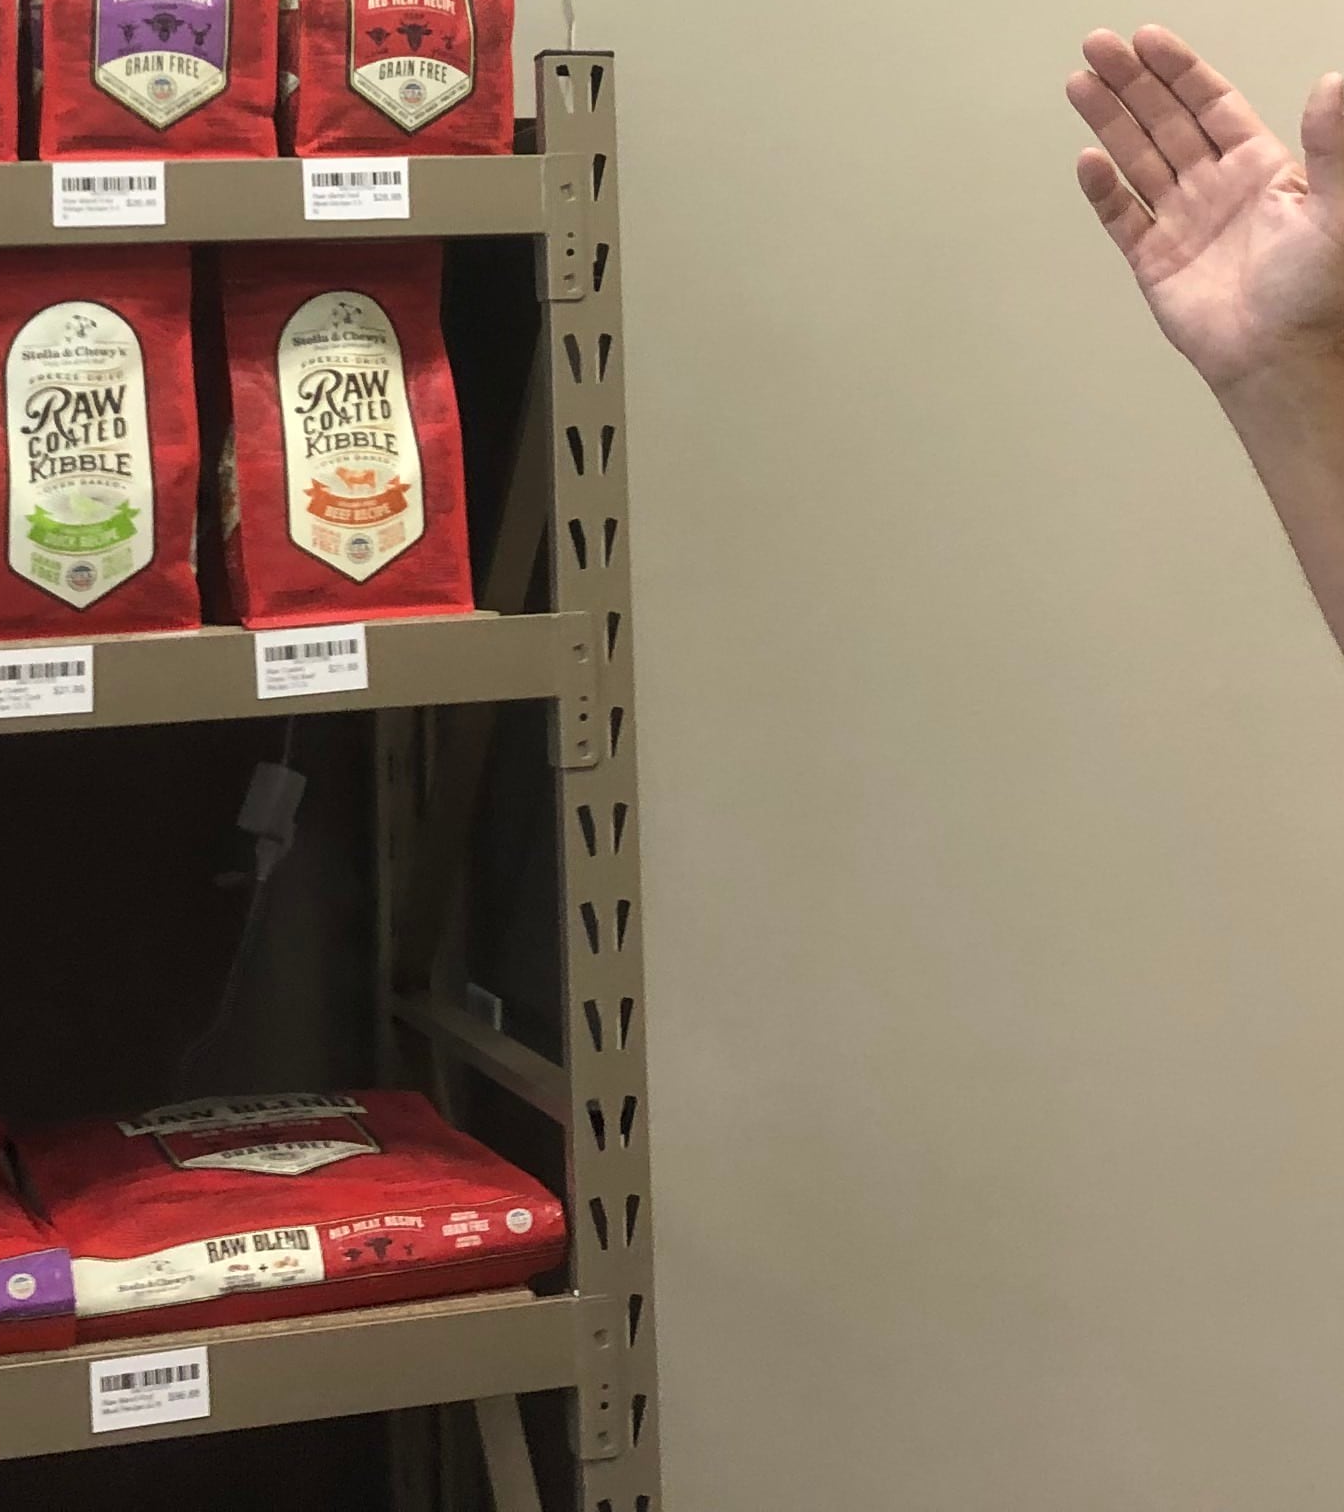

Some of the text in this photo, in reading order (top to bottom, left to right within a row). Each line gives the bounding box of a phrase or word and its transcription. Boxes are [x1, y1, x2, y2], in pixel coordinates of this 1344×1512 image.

[124, 55, 200, 79] GRAIN FREE
[379, 61, 448, 84] GRAIN FREE
[294, 368, 391, 421] RAW
[20, 384, 127, 443] RAW
[302, 399, 393, 436] COATED
[28, 416, 128, 459] COATED
[304, 430, 400, 459] KIBBLE
[28, 452, 133, 484] KIBBLE
[221, 1140, 334, 1159] GRAIN FREE
[206, 1228, 311, 1264] RAW BLEND
